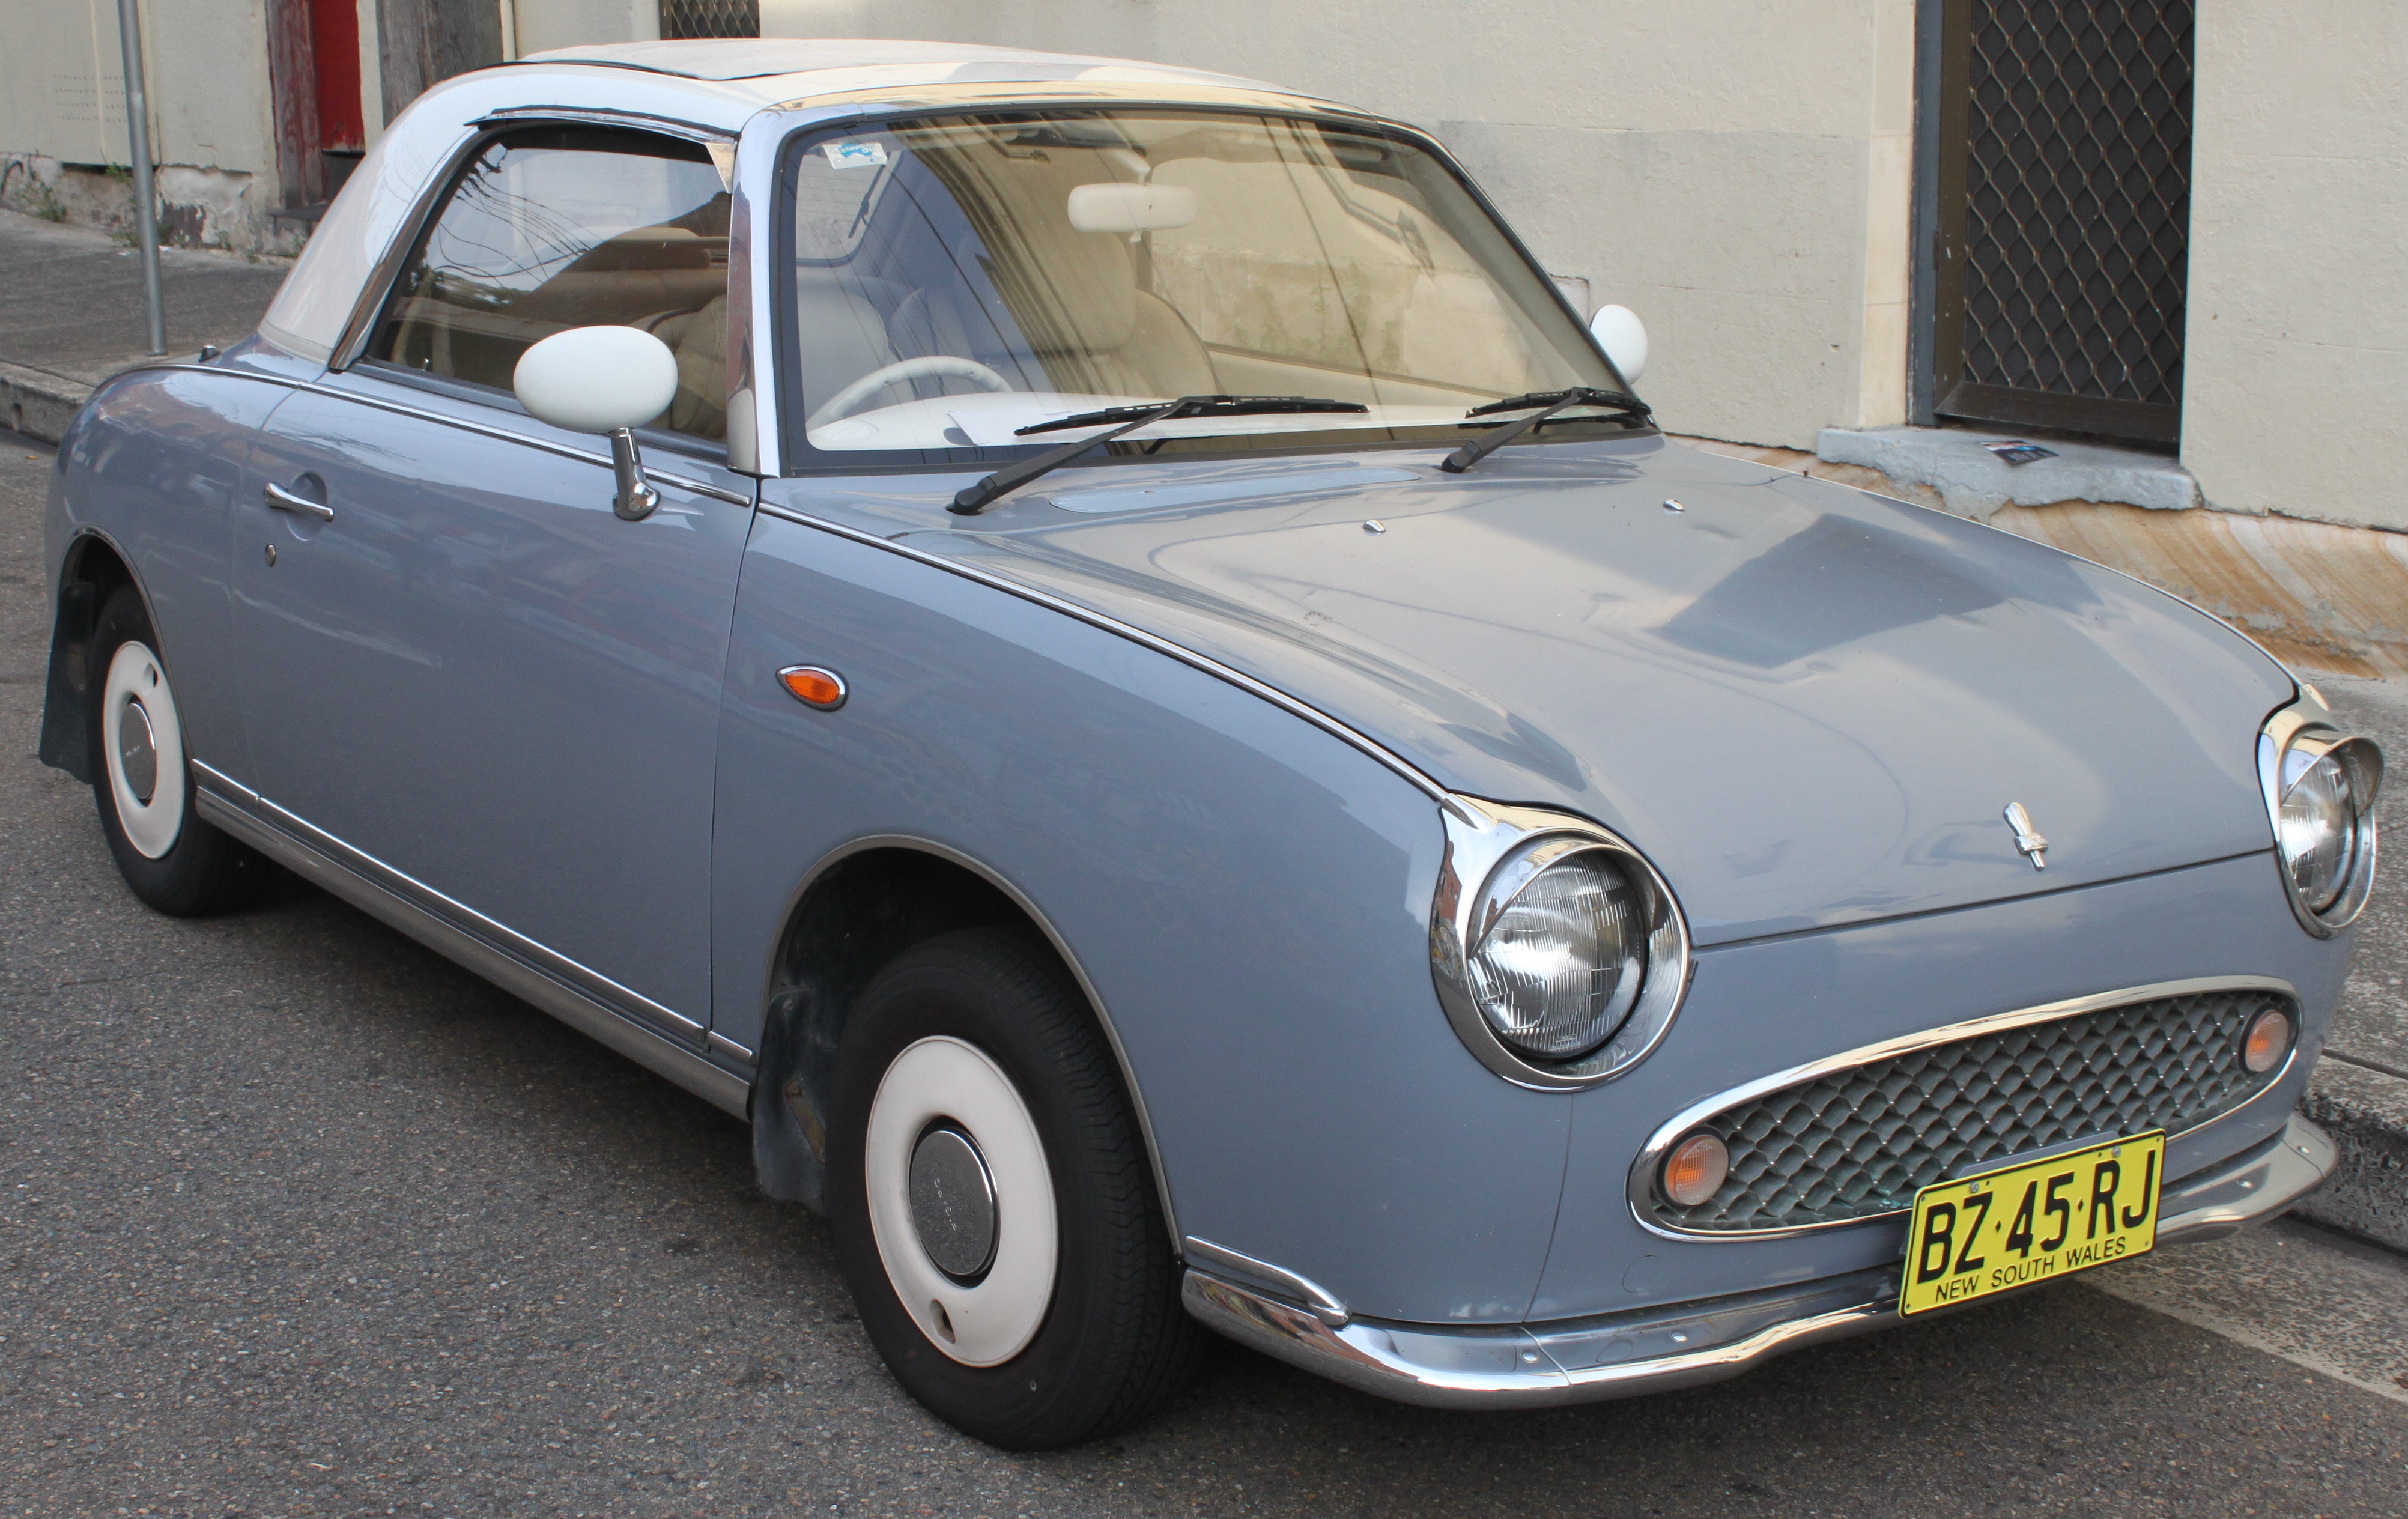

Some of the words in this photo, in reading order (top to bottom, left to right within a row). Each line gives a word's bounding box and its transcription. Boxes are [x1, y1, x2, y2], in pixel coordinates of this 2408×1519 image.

[1935, 1274, 1979, 1302] NEW
[1990, 1254, 2055, 1288] SOUTH
[2066, 1236, 2126, 1268] WALES
